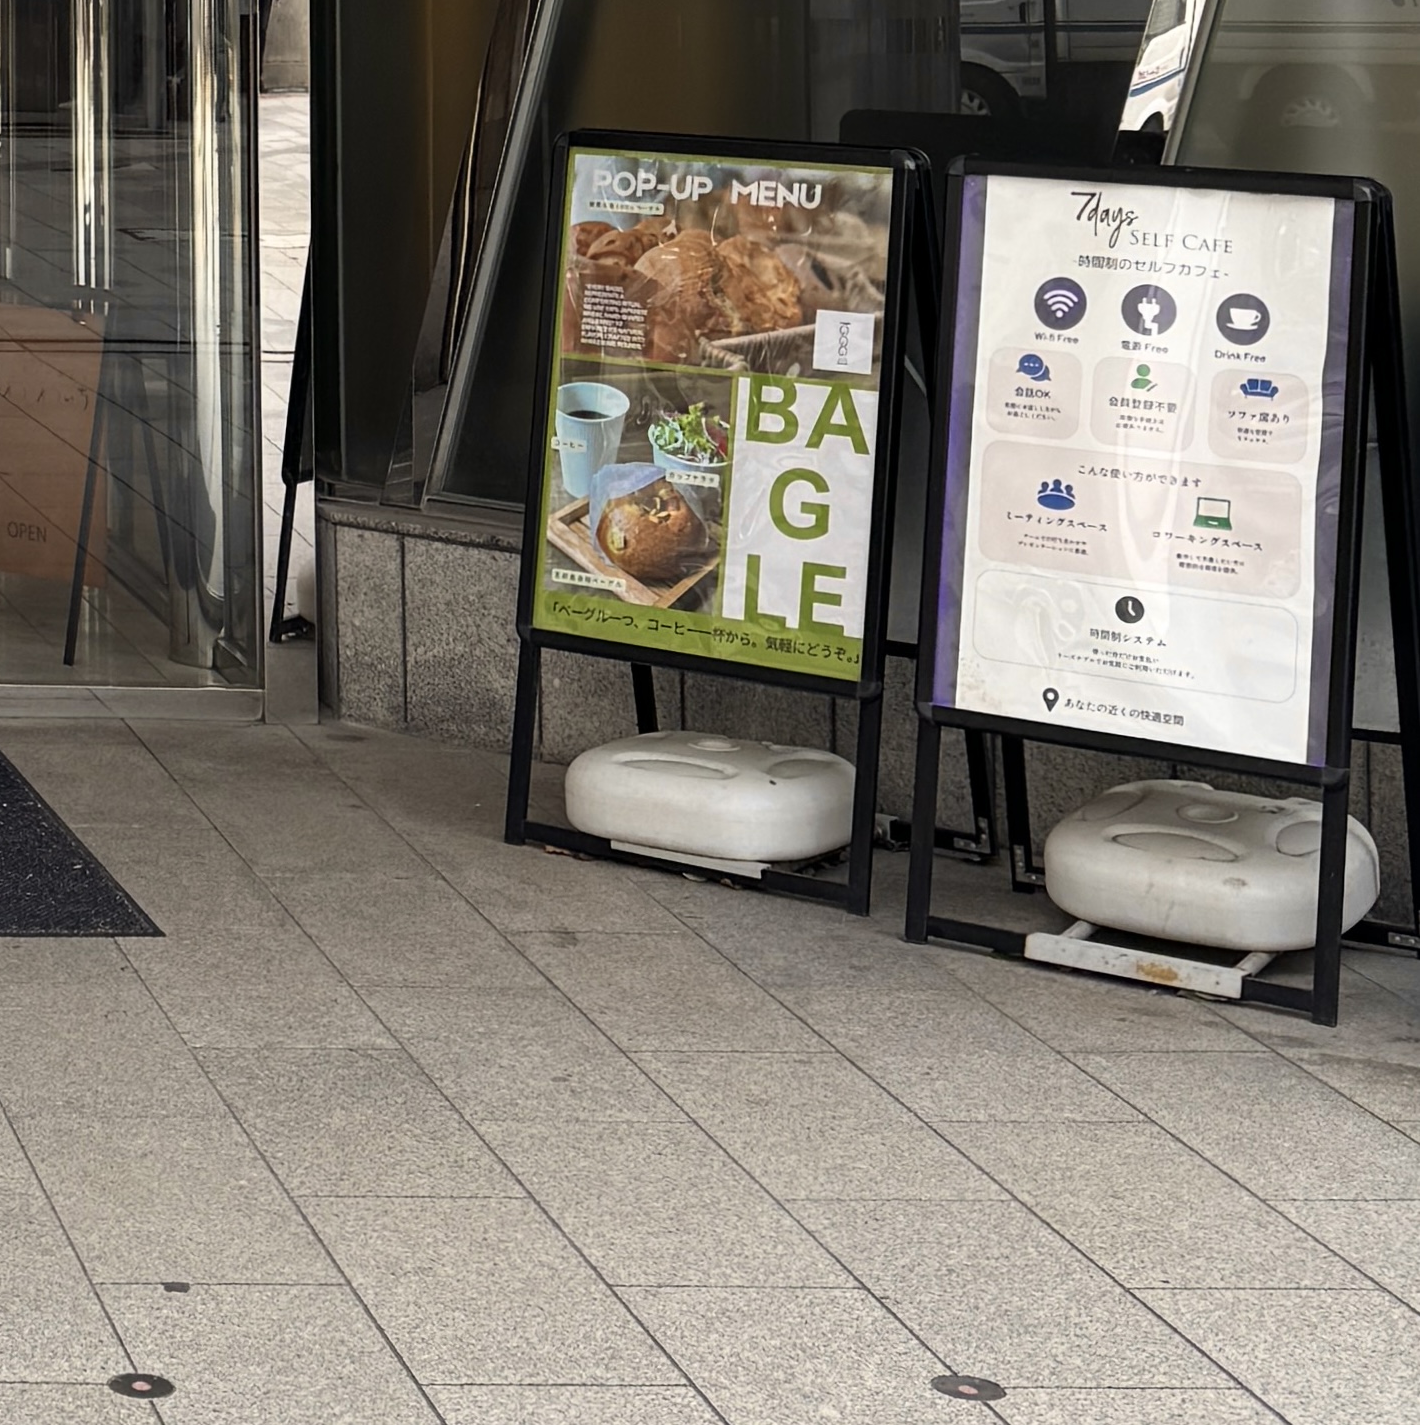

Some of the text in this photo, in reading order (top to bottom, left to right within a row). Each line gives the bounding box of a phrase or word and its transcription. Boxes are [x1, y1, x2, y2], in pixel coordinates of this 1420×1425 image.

[592, 169, 822, 209] POP-UP MENU
[1070, 191, 1139, 248] 7days
[1129, 230, 1233, 254] SELF CAFE
[769, 467, 830, 540] G
[7, 521, 47, 542] OPEN
